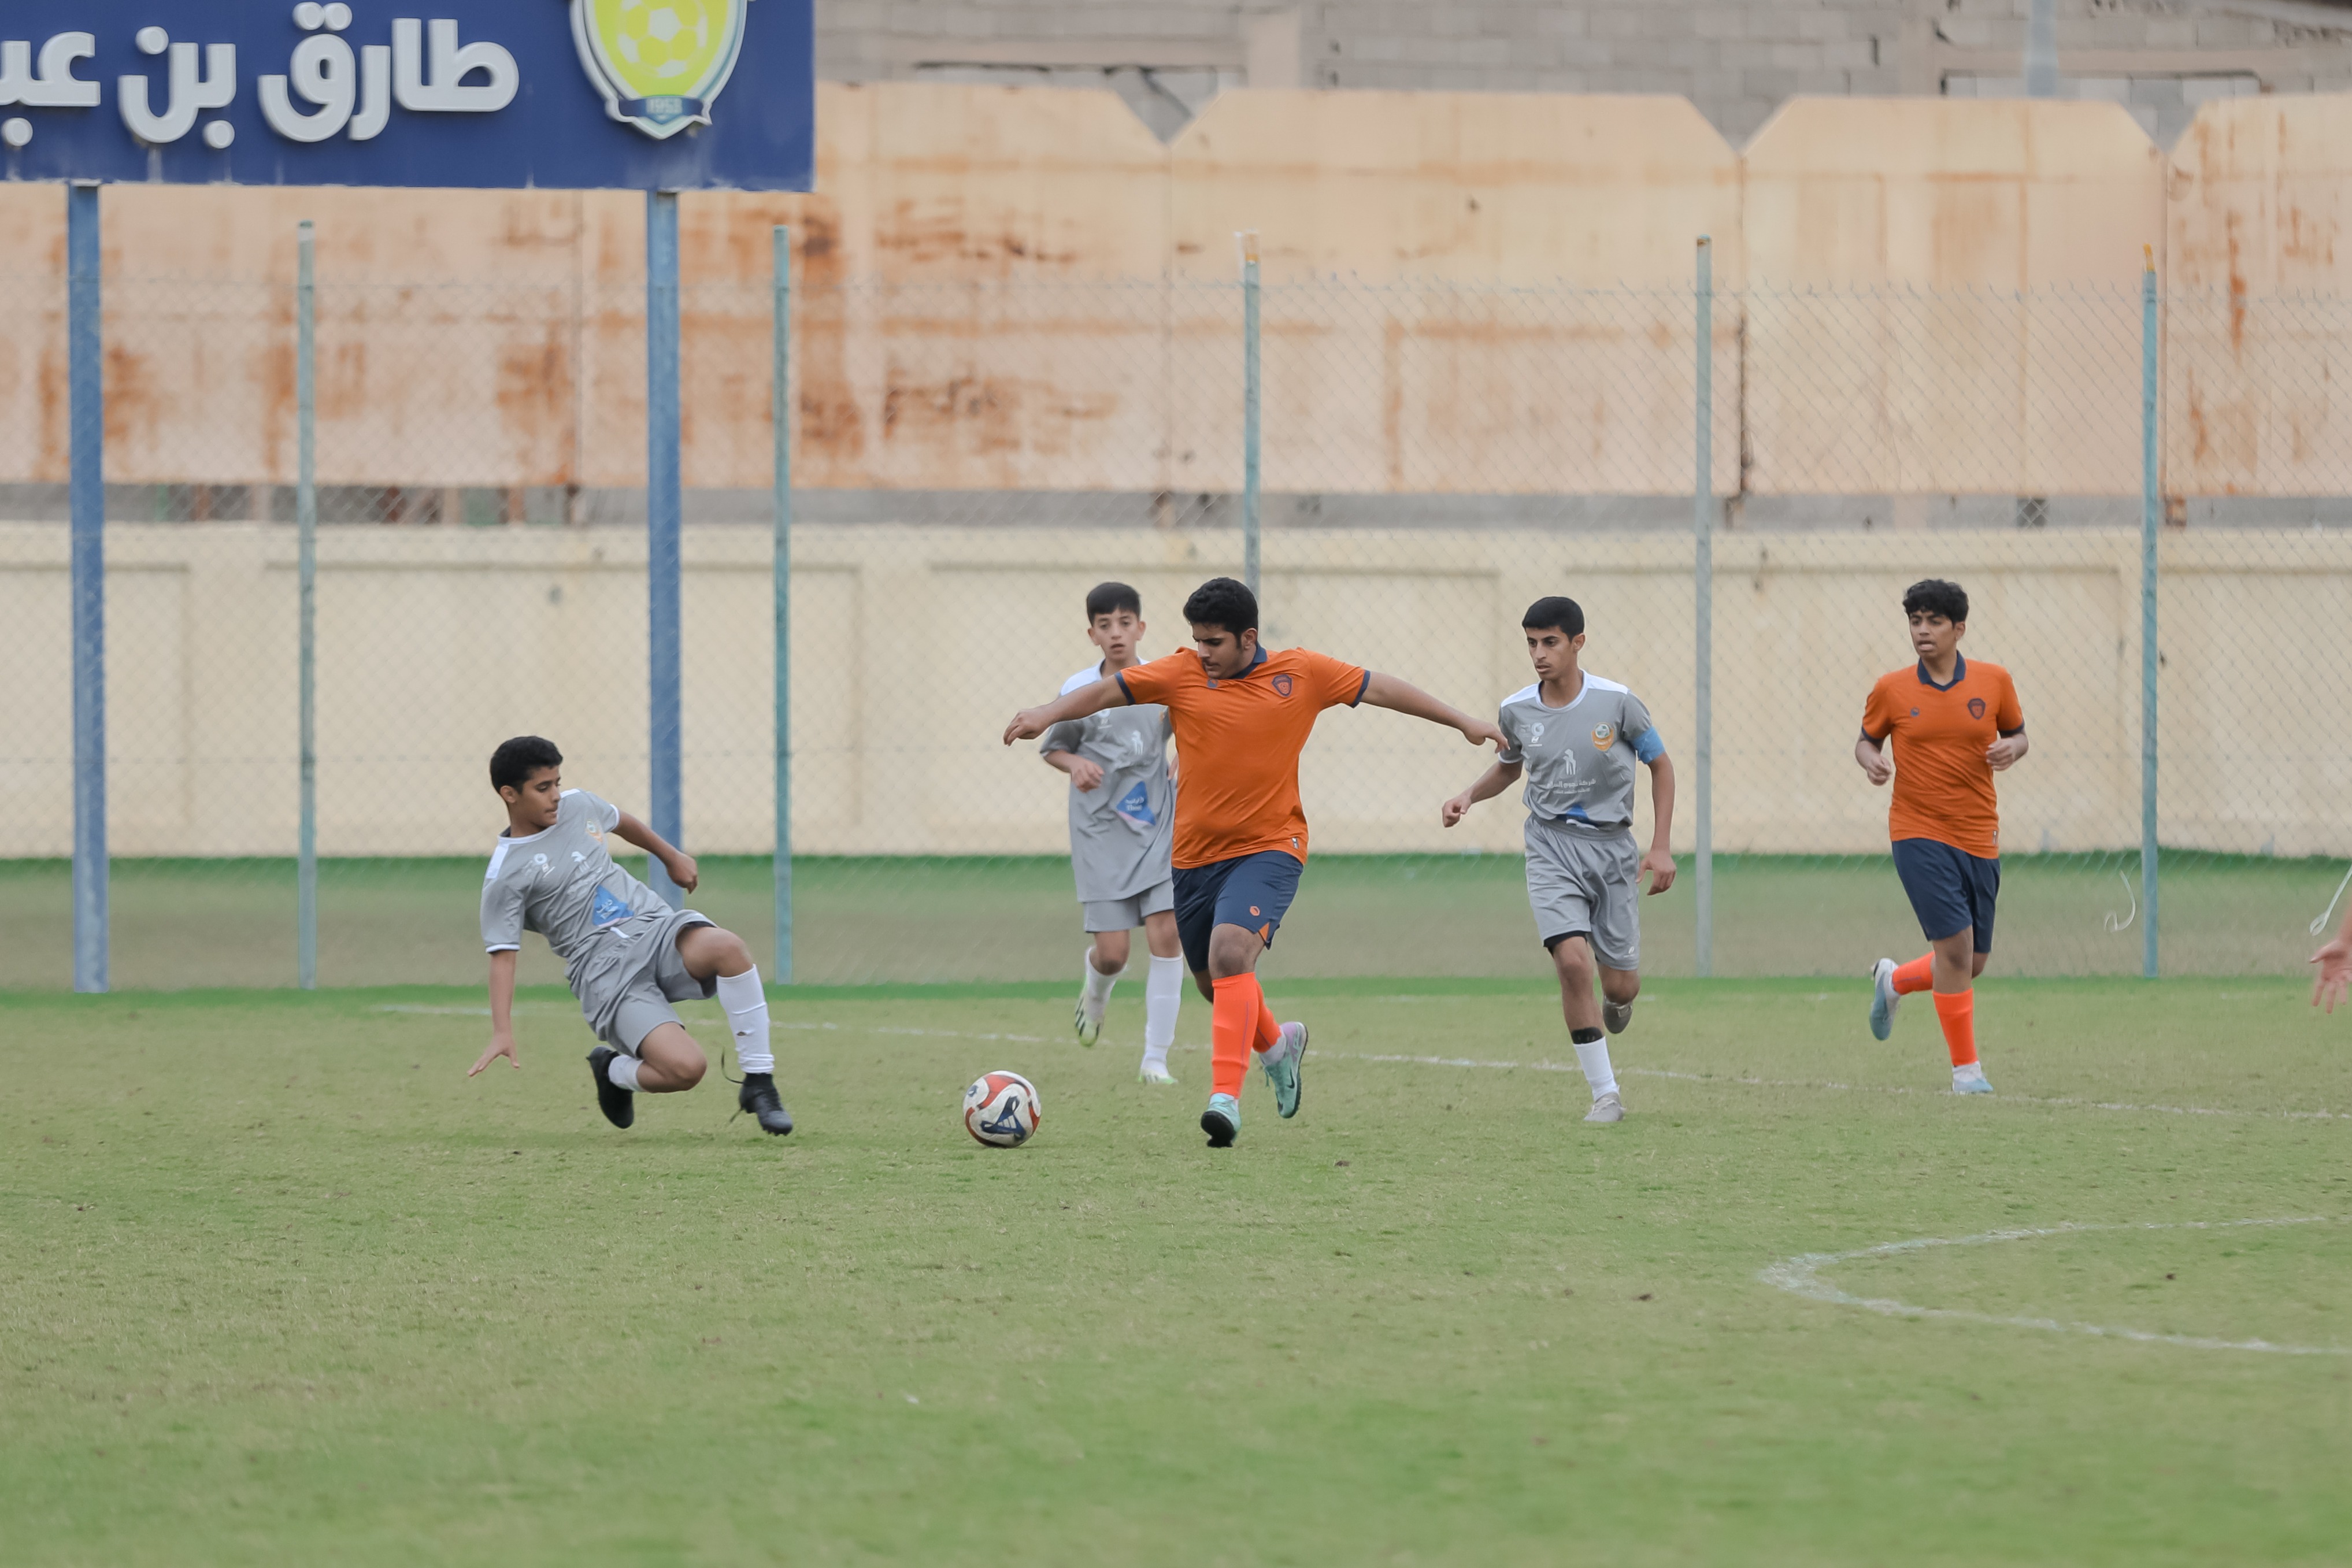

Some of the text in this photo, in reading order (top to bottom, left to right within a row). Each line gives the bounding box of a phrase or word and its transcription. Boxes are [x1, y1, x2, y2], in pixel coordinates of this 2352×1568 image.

[0, 1, 519, 149] طارق بن عب
